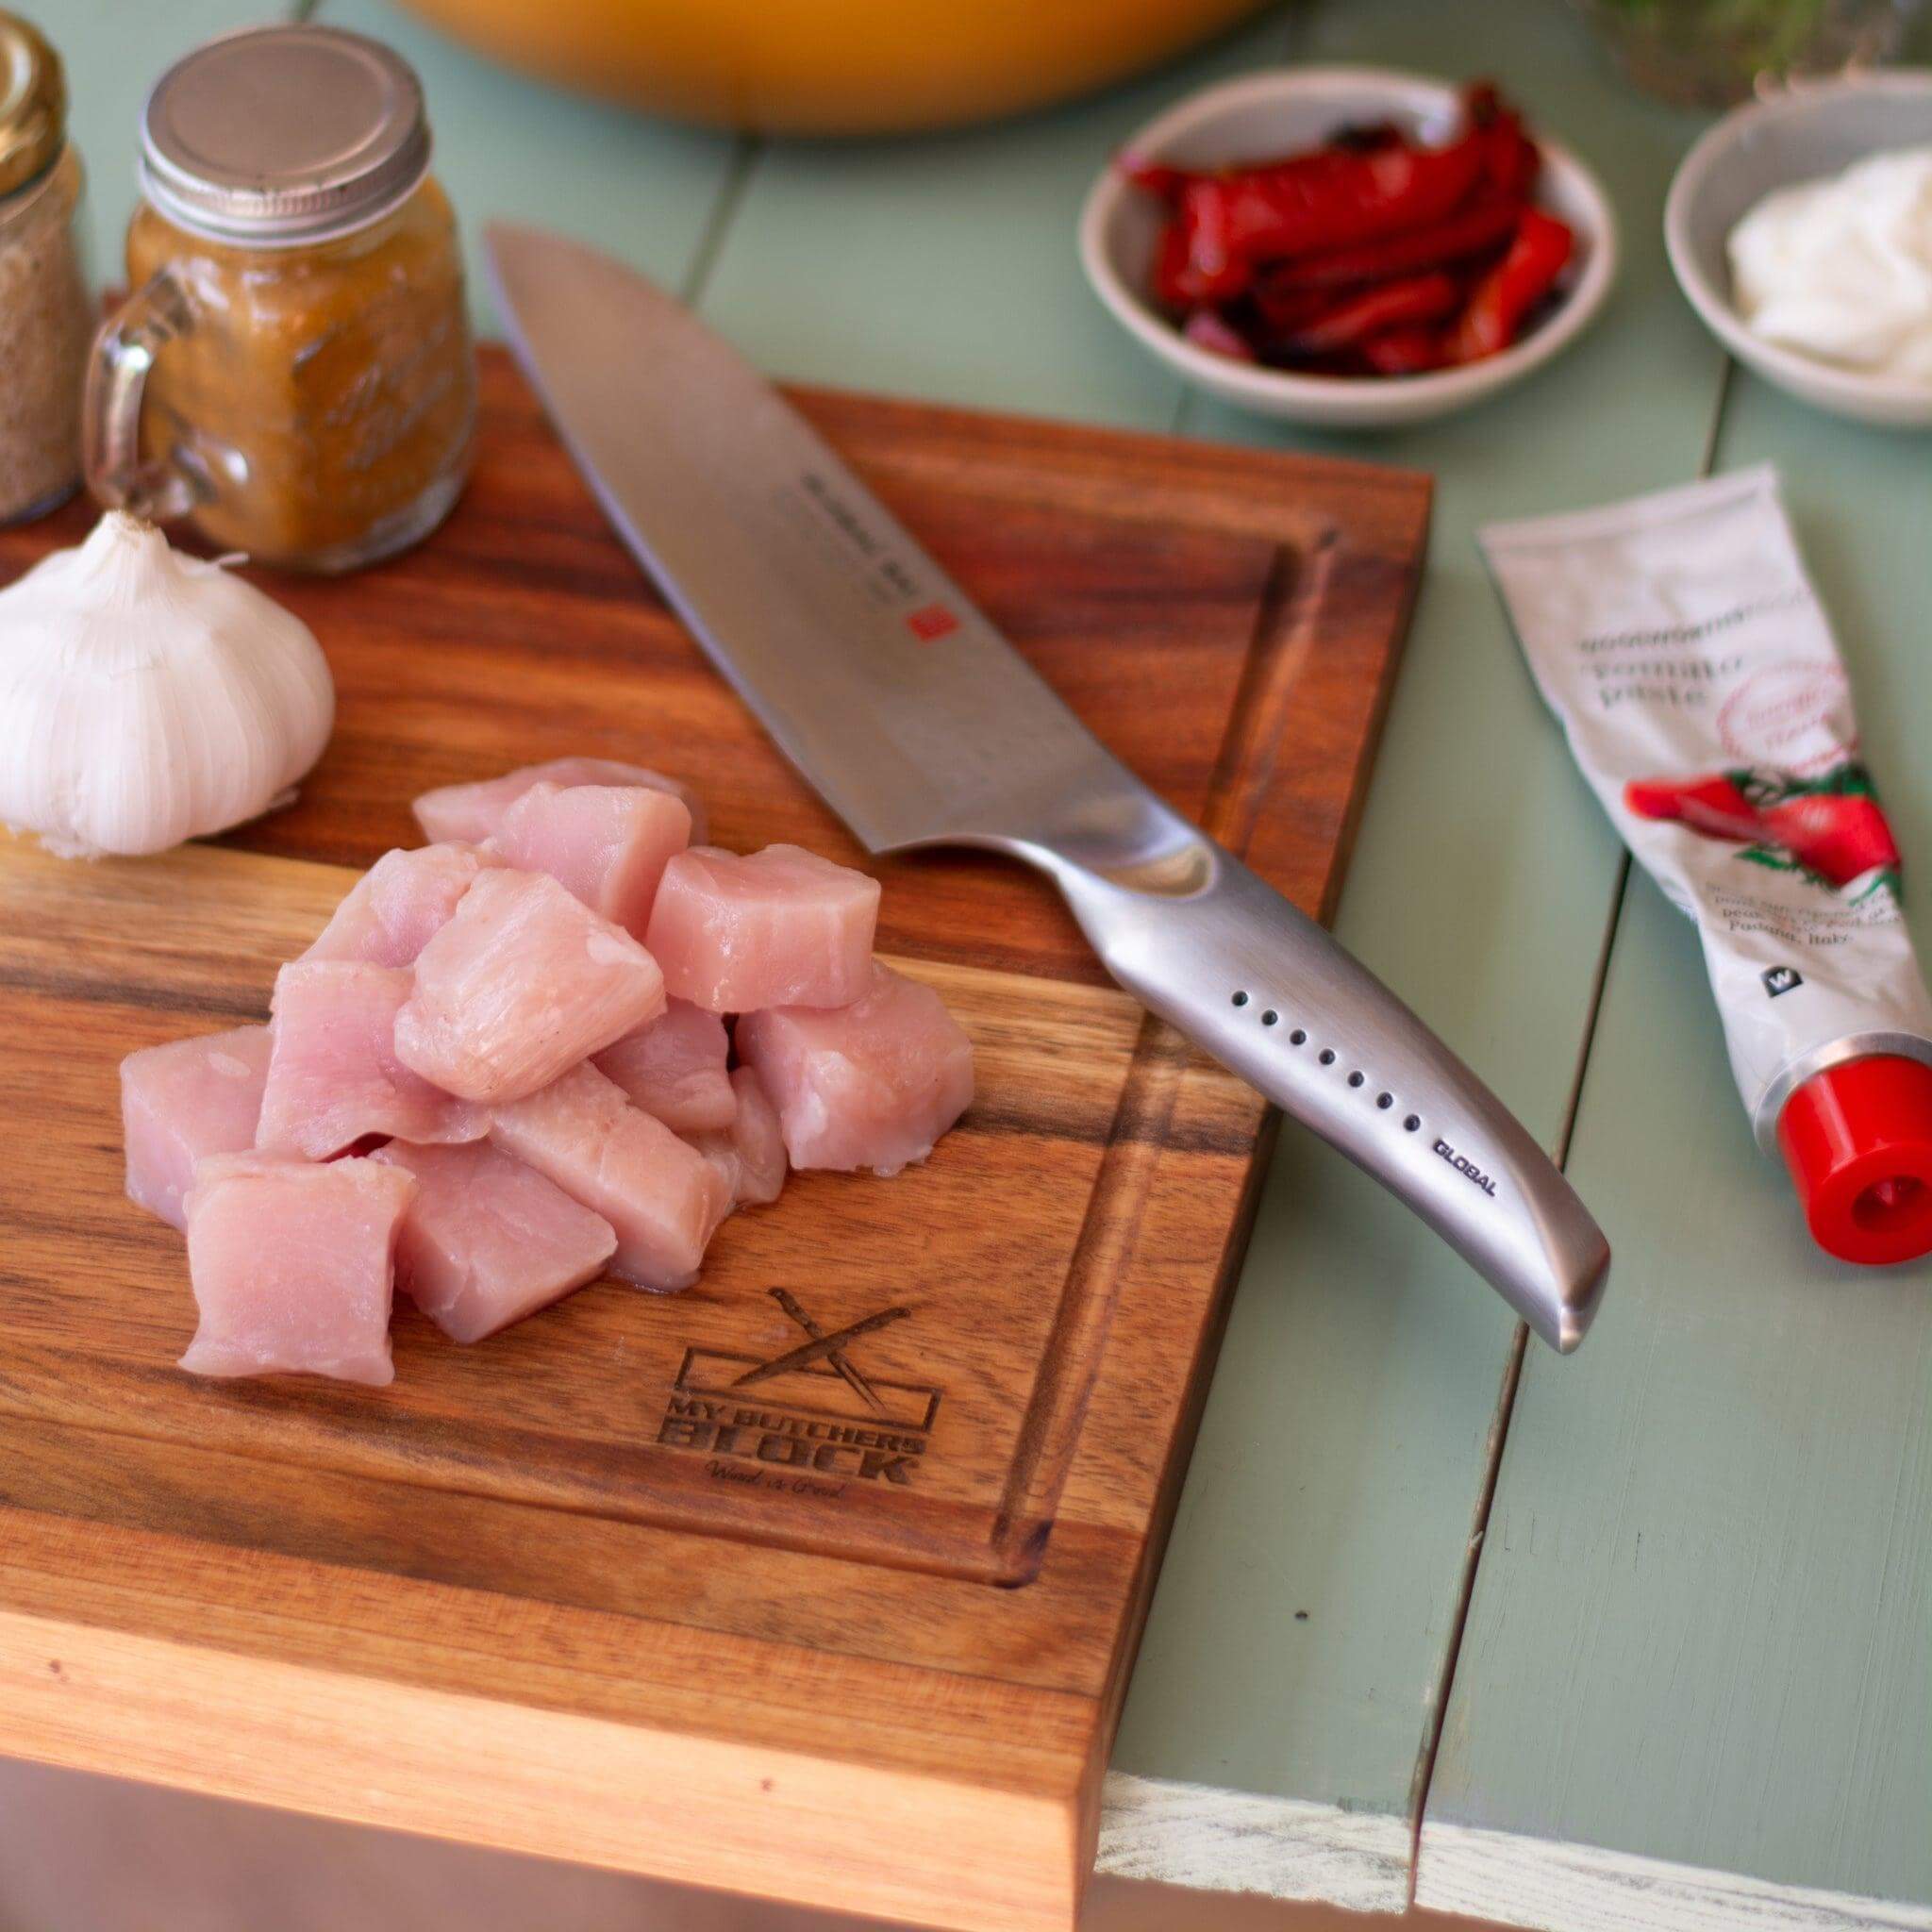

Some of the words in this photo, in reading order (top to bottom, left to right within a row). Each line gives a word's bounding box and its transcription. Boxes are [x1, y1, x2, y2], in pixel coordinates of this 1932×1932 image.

[1433, 1139, 1496, 1197] GLOBAL
[658, 1417, 920, 1484] BLOCK
[666, 1399, 725, 1419] MY
[732, 1408, 926, 1455] BUTCHERS
